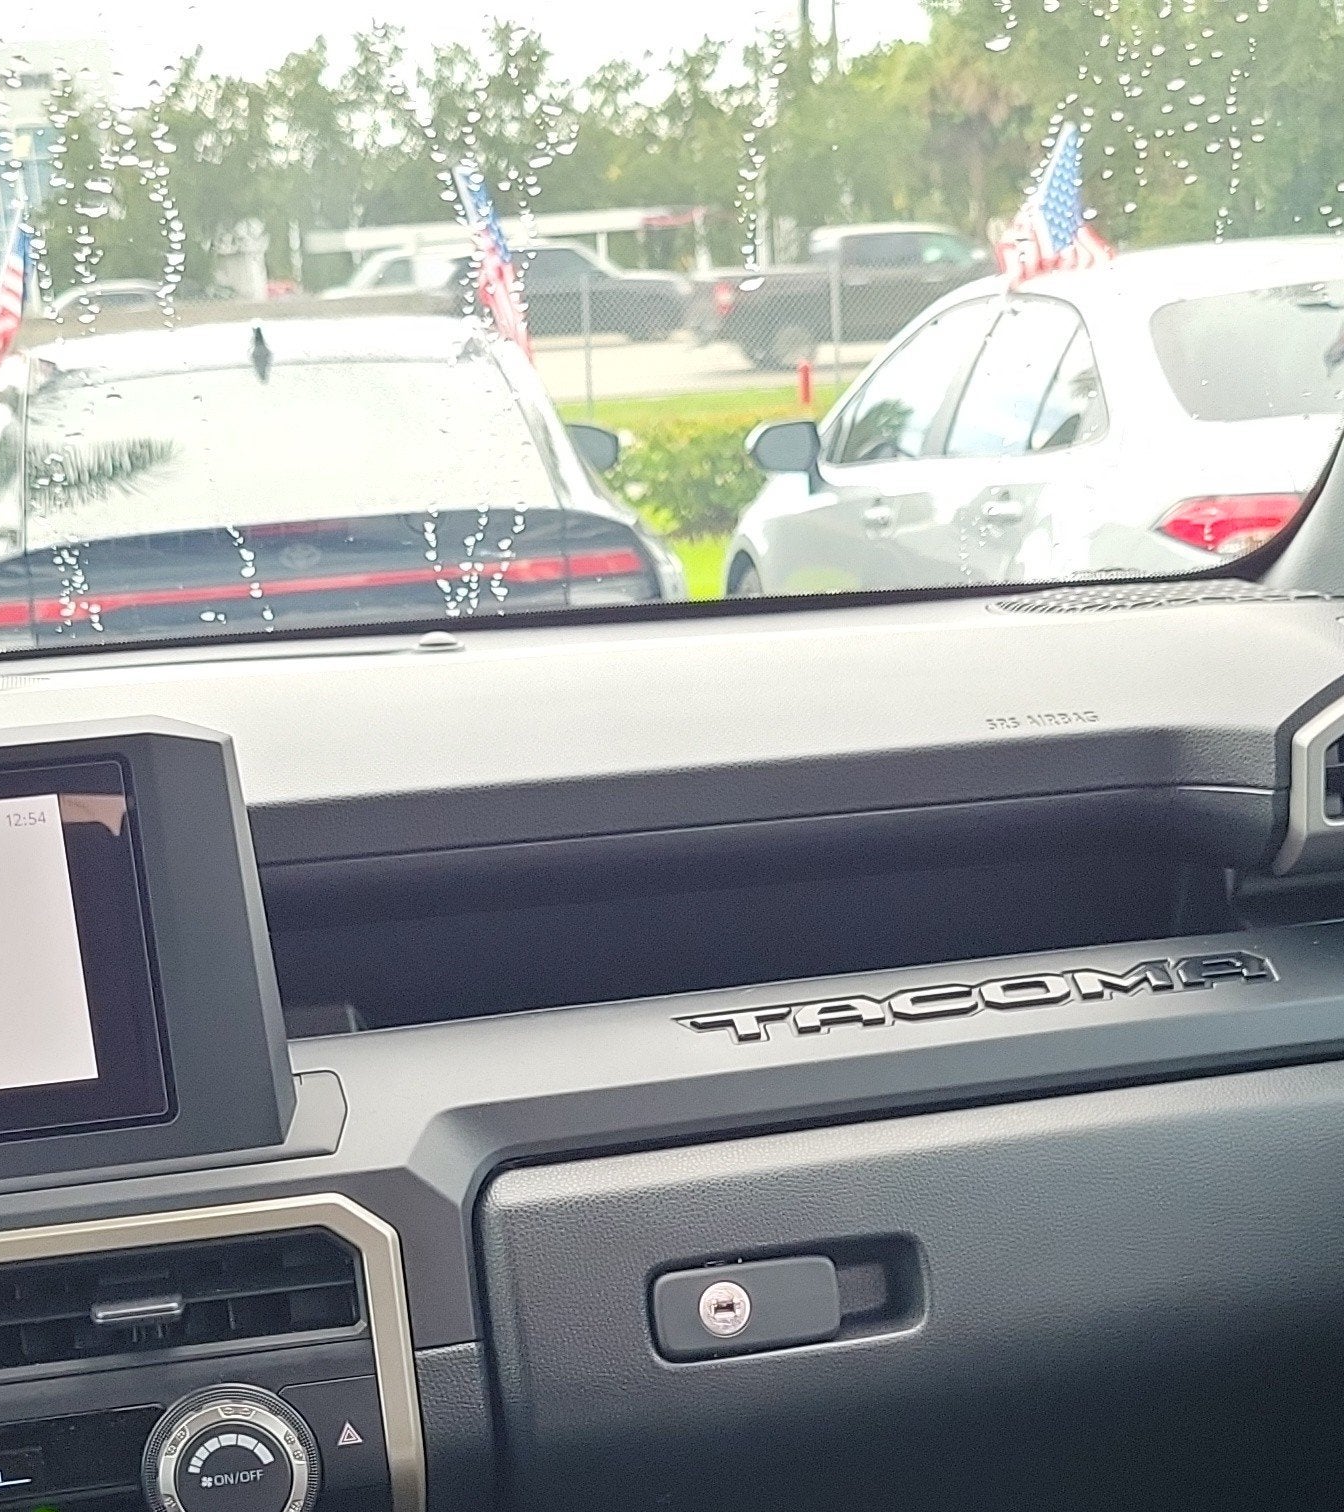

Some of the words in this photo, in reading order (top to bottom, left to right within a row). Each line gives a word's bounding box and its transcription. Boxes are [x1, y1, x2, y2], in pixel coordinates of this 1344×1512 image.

[985, 717, 1020, 730] SRS
[1027, 711, 1099, 727] AIRBAG
[6, 811, 46, 828] 12:54
[671, 950, 1281, 1044] TACOMA
[214, 1469, 265, 1486] ON/OFF
